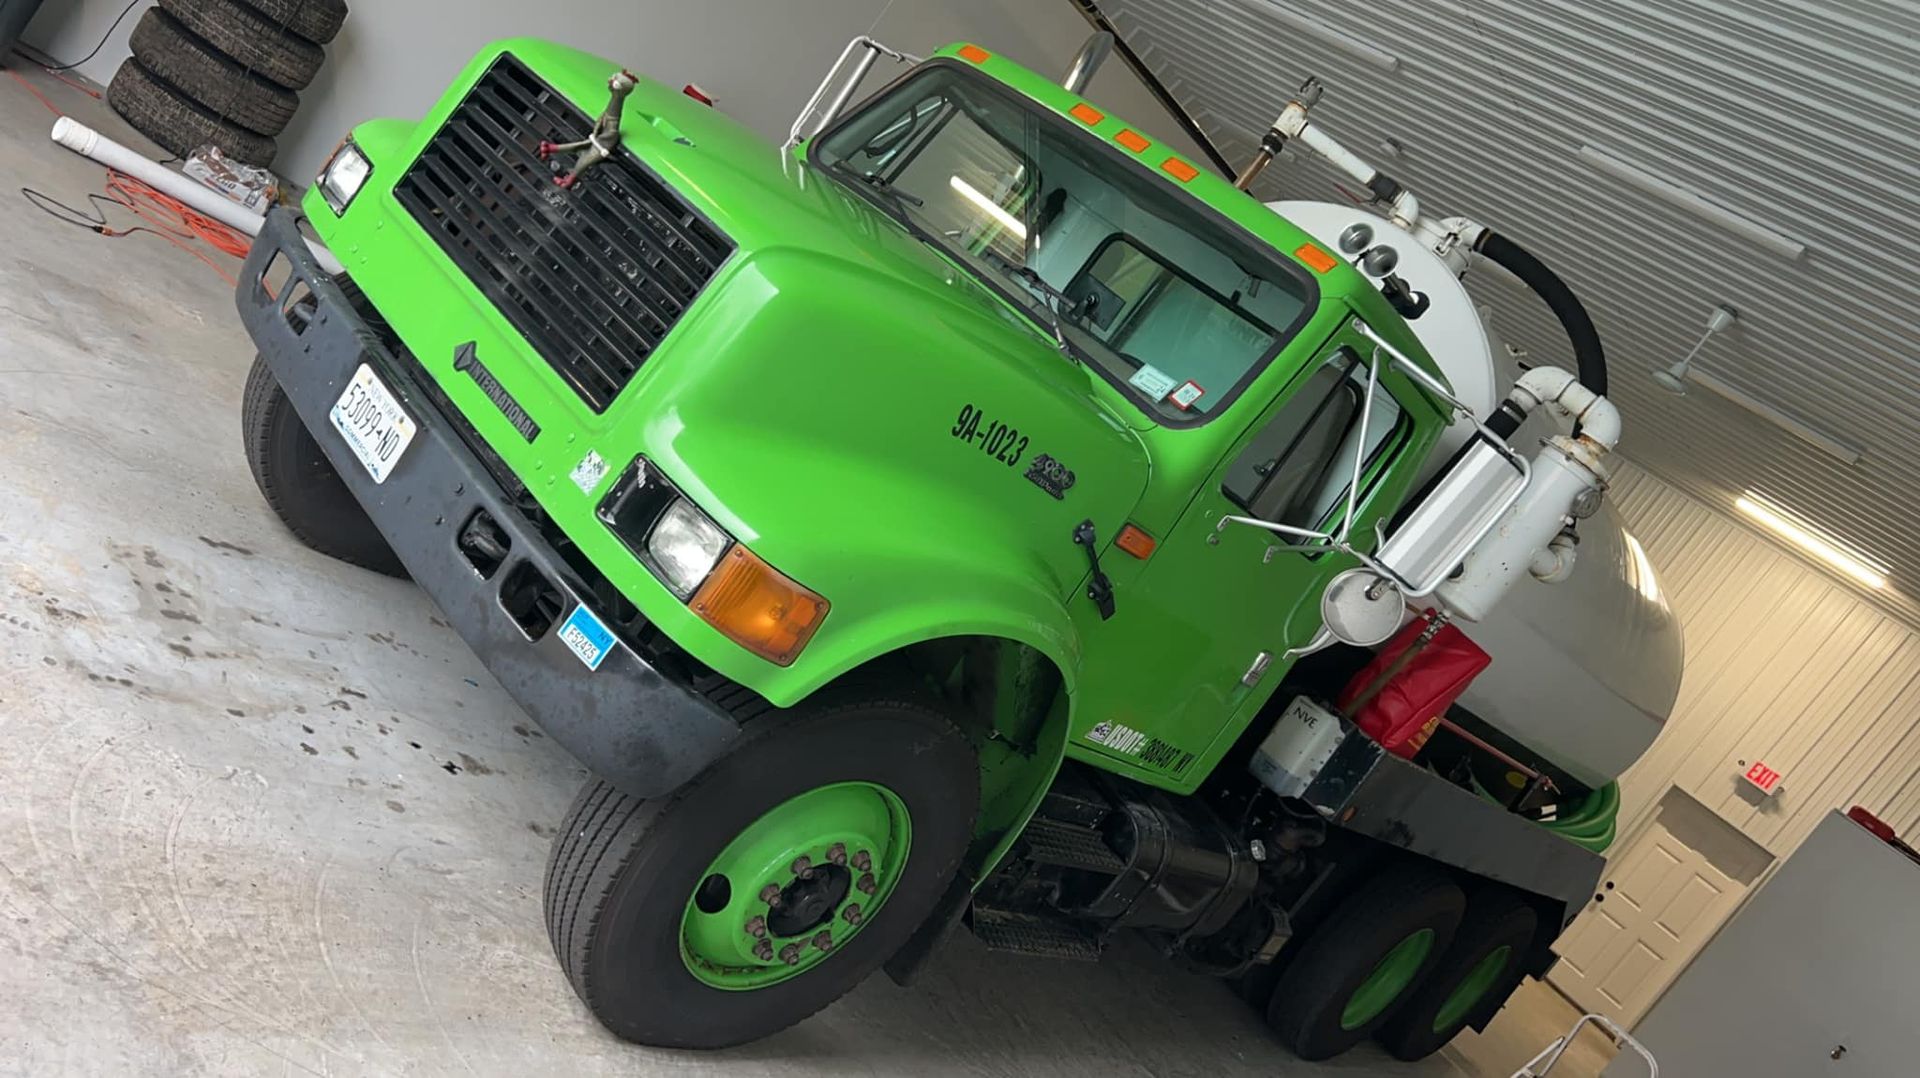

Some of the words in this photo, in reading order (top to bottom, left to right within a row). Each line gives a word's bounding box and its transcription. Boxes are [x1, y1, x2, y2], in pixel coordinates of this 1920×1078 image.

[469, 361, 536, 438] INTERNATIONAL
[952, 404, 1029, 467] 9A-1023
[567, 627, 597, 660] F52425
[1293, 707, 1318, 729] NVE
[1746, 762, 1781, 789] EXIT
